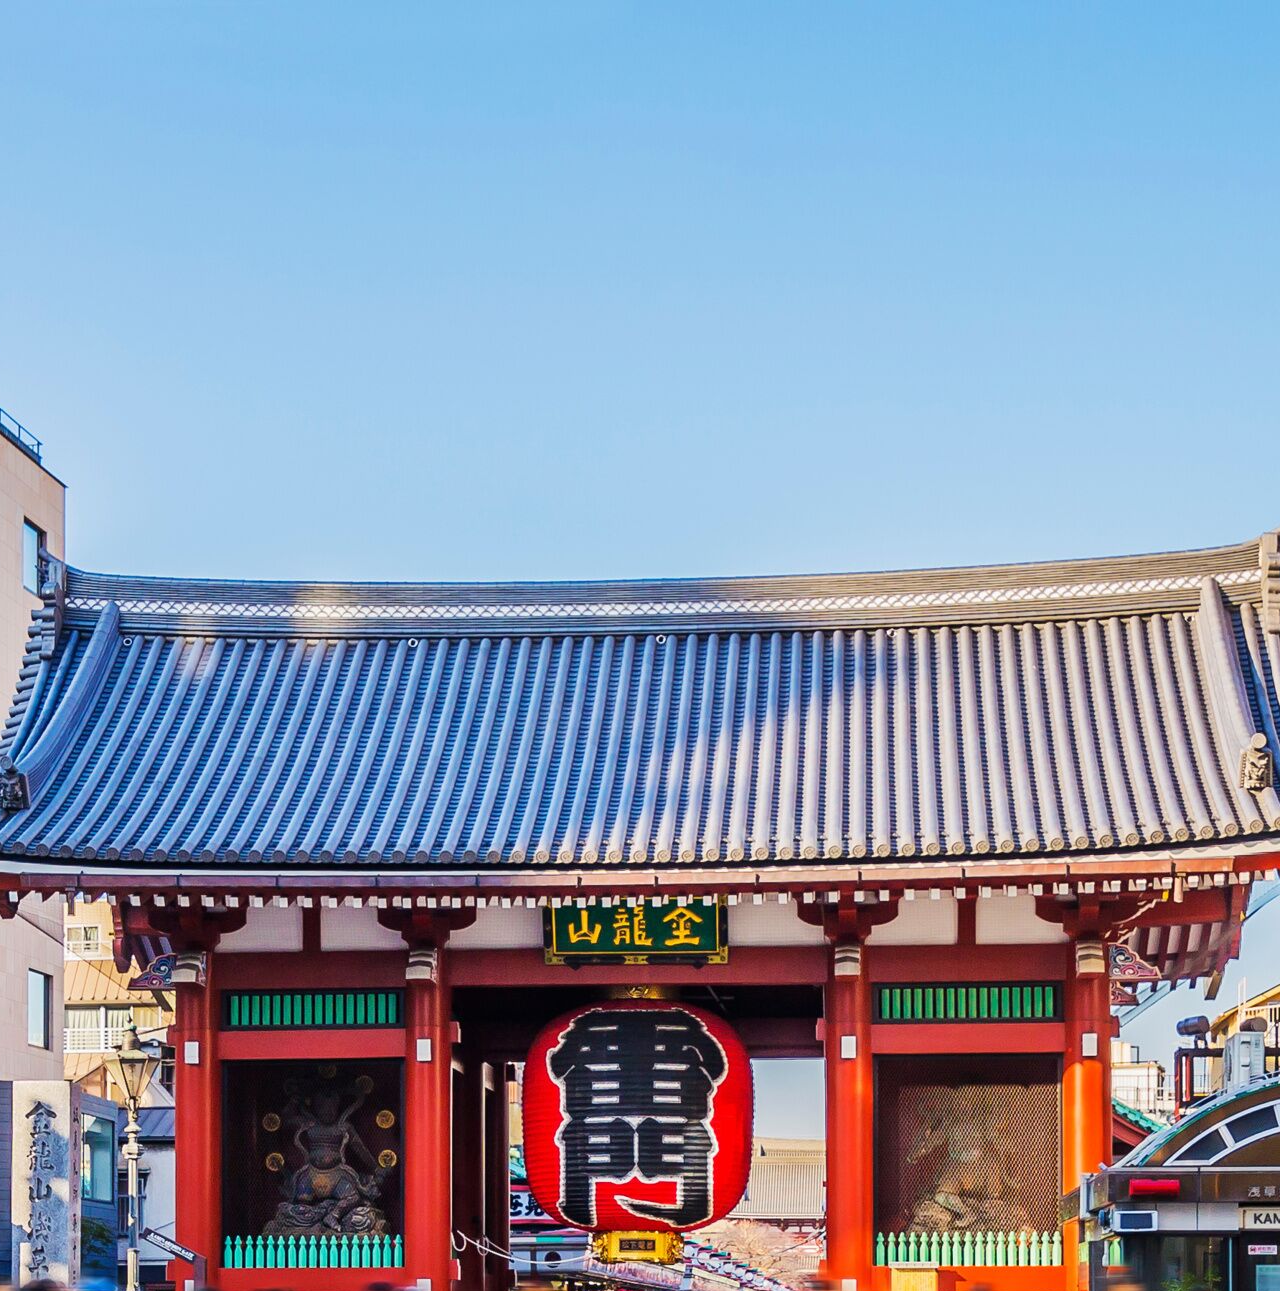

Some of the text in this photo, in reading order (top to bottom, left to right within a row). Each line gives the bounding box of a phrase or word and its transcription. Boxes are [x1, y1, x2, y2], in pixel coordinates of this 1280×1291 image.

[567, 905, 705, 947] 金龍山
[546, 1007, 728, 1228] 雷門
